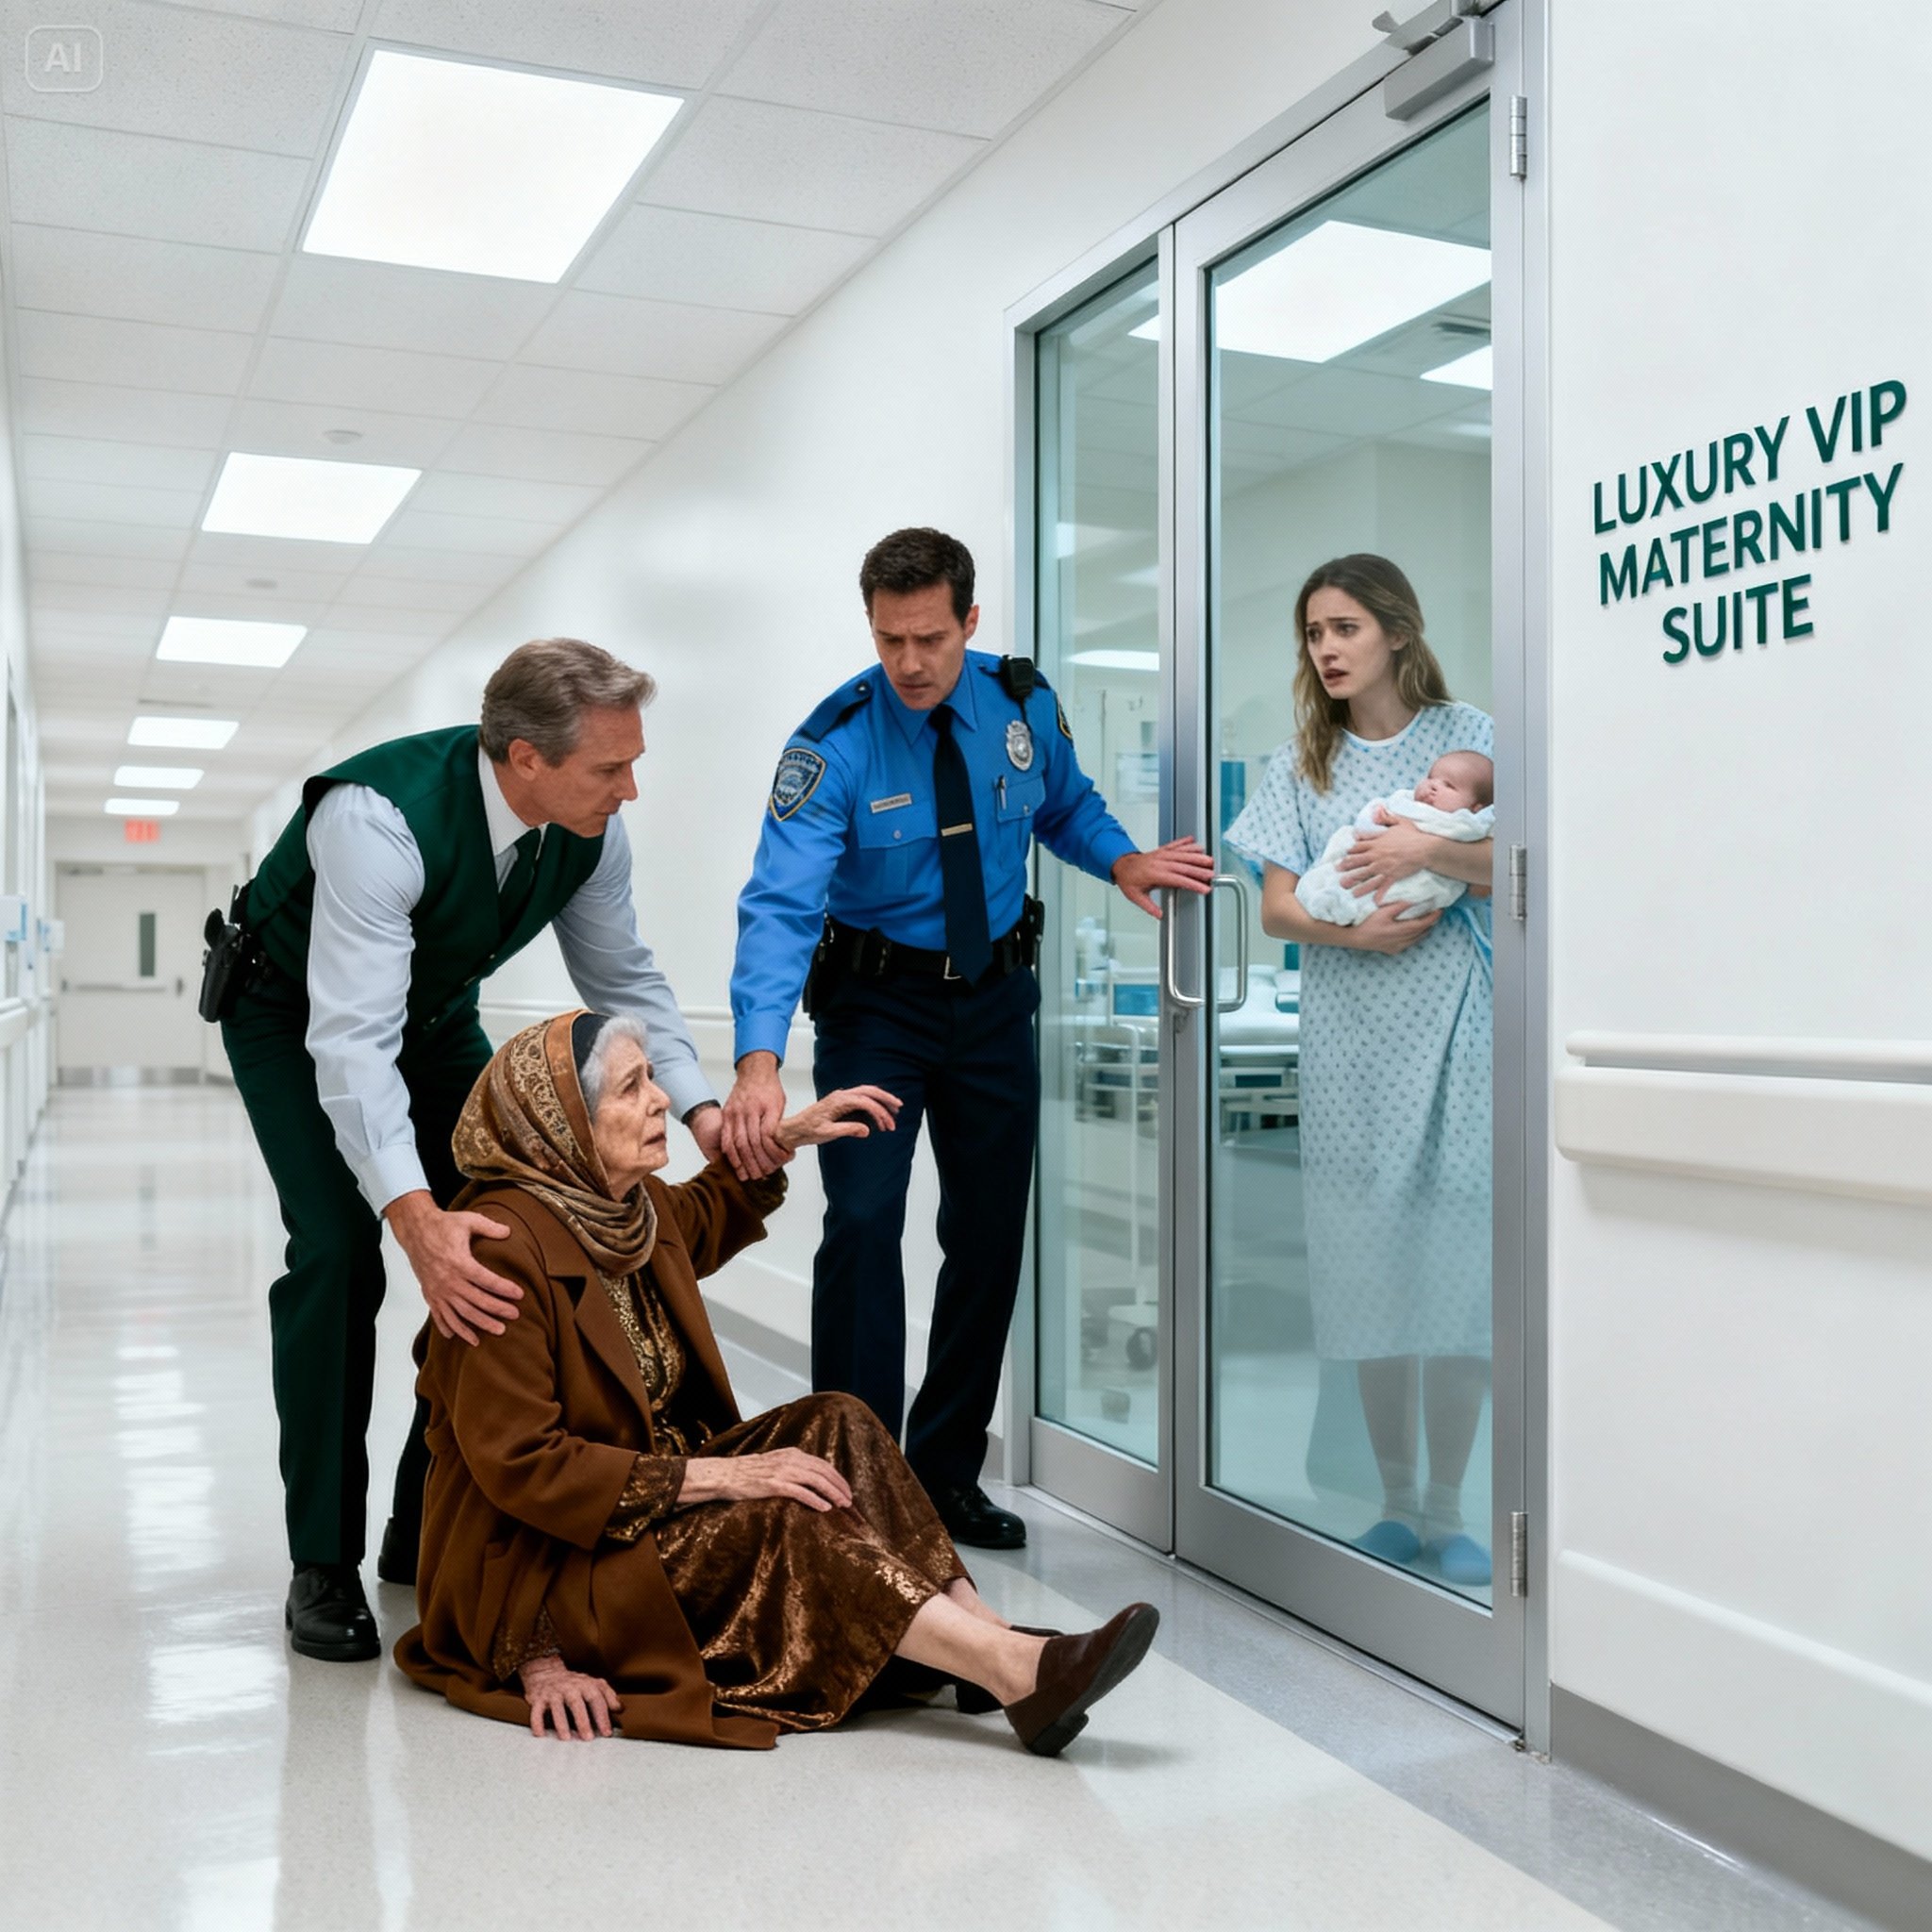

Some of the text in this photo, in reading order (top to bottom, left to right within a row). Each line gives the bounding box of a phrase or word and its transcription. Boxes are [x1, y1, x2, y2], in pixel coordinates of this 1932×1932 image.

[1593, 379, 1907, 535] LUXURY VIP
[1600, 462, 1904, 607] MATERNITY
[1662, 574, 1814, 665] SUITE
